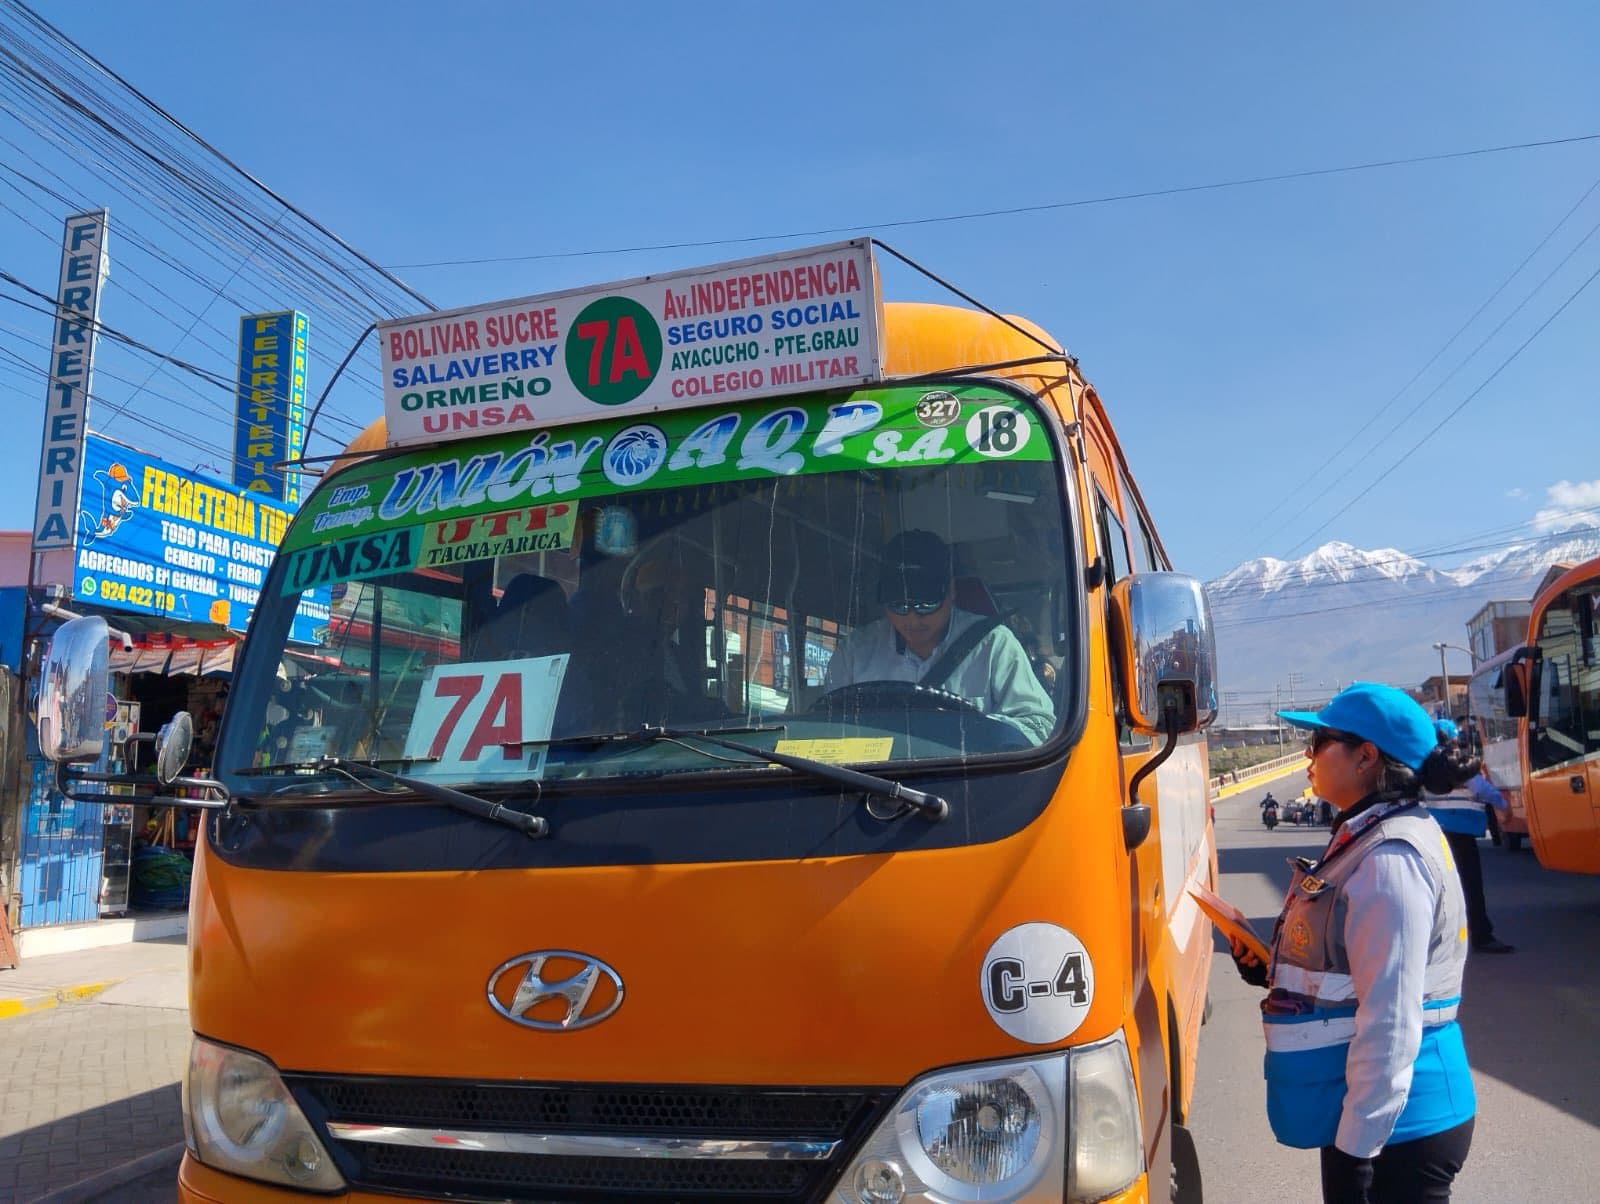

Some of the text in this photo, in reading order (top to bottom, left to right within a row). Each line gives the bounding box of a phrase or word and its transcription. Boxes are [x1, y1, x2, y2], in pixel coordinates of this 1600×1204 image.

[389, 307, 560, 363] BOLIVAR SUCRE
[667, 300, 861, 346] SEGURO SOCIAL
[392, 343, 558, 389] SALAVERRY
[577, 316, 652, 387] 7A
[671, 341, 759, 371] AYACUCHO
[37, 222, 98, 542] FERRETERIA
[400, 376, 552, 413] ORMEÑO
[671, 356, 860, 398] COLEGIO MILITAR
[247, 318, 280, 493] FERRETERIA
[422, 403, 536, 434] UNSA
[918, 400, 957, 418] 327
[978, 410, 1018, 452] 18
[378, 432, 603, 521] UNIÓN
[667, 399, 883, 475] AQP
[141, 465, 255, 539] FERRETERÍA
[328, 484, 371, 508] Emp.
[161, 520, 196, 548] TODO
[198, 530, 230, 558] PARA
[436, 504, 570, 545] UTP
[164, 545, 215, 574] CEMENTO
[227, 562, 262, 586] FIERRO
[296, 529, 414, 586] UNSA
[427, 541, 489, 564] TACNA
[501, 532, 561, 555] ARICA
[78, 549, 154, 583] AGREGADOS
[171, 570, 218, 597] GENERAL
[296, 599, 330, 620] NTURAS
[100, 579, 126, 602] 924
[128, 586, 153, 607] 422
[427, 672, 523, 761] 7A
[987, 952, 1089, 1014] C-4
